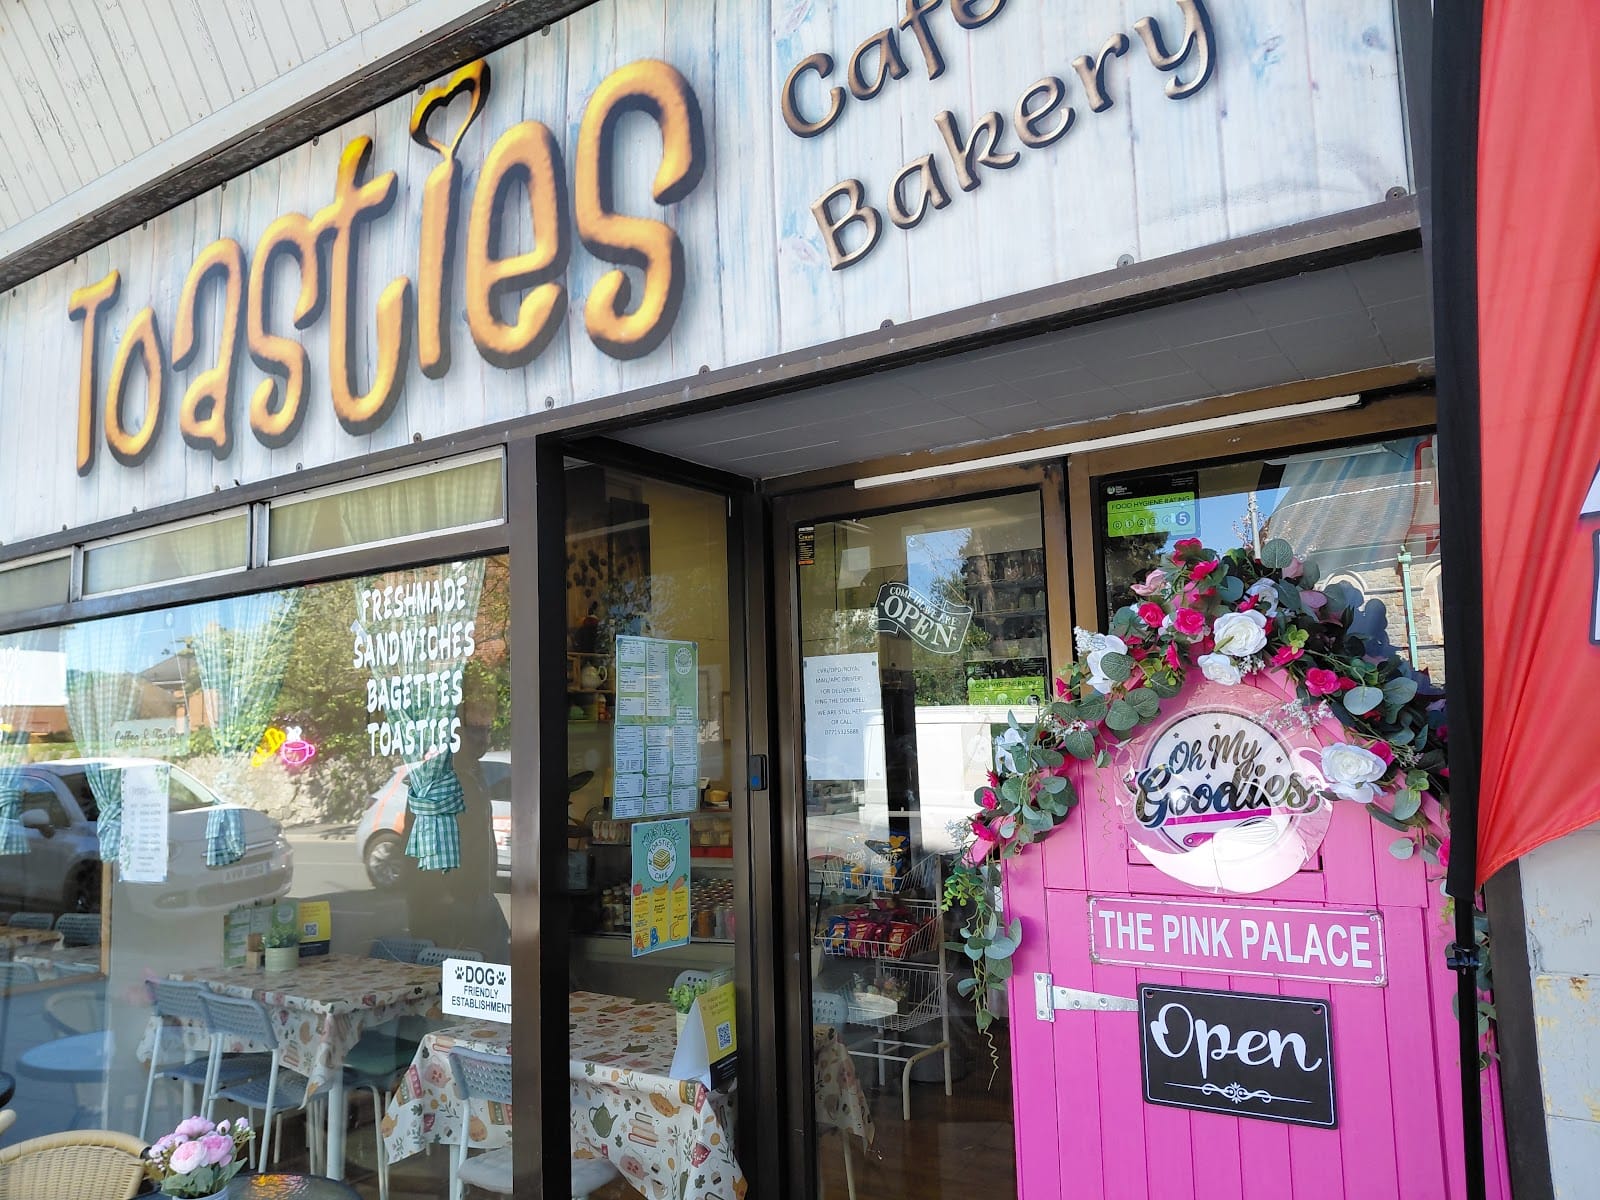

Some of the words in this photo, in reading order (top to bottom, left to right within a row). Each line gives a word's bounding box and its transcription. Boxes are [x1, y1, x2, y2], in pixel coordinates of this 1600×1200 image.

[810, 0, 1215, 270] Bakery
[68, 57, 707, 477] Toasties
[1111, 502, 1132, 510] FOOD
[1134, 498, 1165, 508] HYGIENE
[1165, 495, 1190, 504] RATING
[362, 575, 468, 621] FRESHMADE
[889, 587, 913, 600] COME
[938, 612, 956, 626] ARE
[884, 595, 956, 648] OPEN
[367, 670, 463, 713] BAGETTES
[367, 717, 462, 757] TOASTIES
[1168, 739, 1206, 775] Oh
[1207, 730, 1262, 778] My
[1135, 763, 1319, 828] Goodies
[1099, 910, 1155, 951] THE
[1162, 914, 1233, 959] PINK
[1240, 919, 1373, 968] PALACE
[464, 985, 499, 999] FRIENDLY
[466, 965, 495, 986] DOG
[451, 995, 512, 1014] ESTABLISHMENT
[1150, 1003, 1323, 1079] Open
